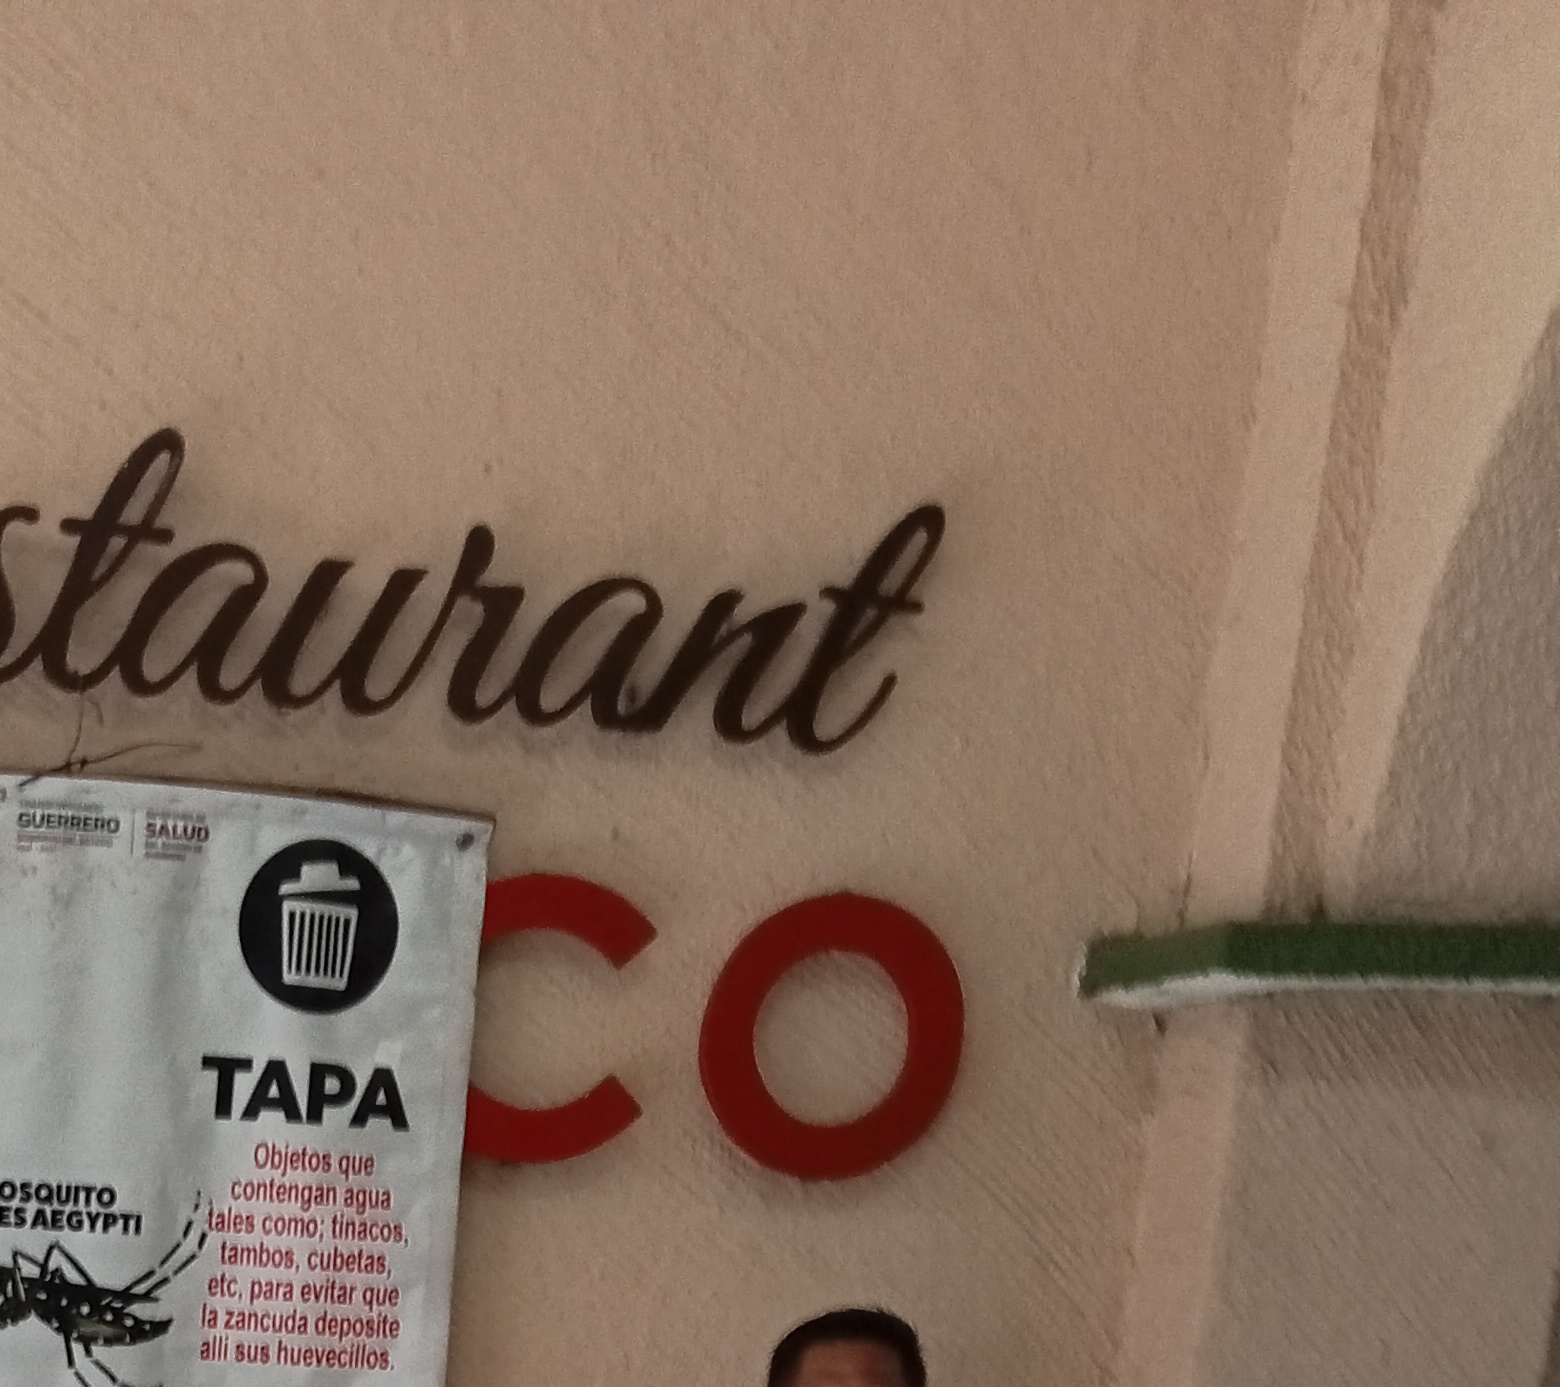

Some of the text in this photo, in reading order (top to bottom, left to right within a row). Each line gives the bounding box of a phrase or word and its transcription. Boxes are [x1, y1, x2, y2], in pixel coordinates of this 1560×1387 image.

[145, 822, 211, 844] SALUD
[201, 1055, 410, 1132] TAPA
[254, 1142, 375, 1181] Objetos que
[230, 1178, 391, 1216] contengan agua
[30, 1208, 144, 1236] AEGYPTI
[208, 1206, 255, 1235] tales
[332, 1212, 410, 1248] tinacos,
[220, 1241, 392, 1280] tambos, cubetas,
[250, 1281, 294, 1306] para
[300, 1279, 357, 1305] evitar
[362, 1285, 400, 1313] que
[201, 1302, 401, 1342] la zancuda deposite
[234, 1342, 271, 1364] sus
[276, 1340, 395, 1371] huevecillos.
